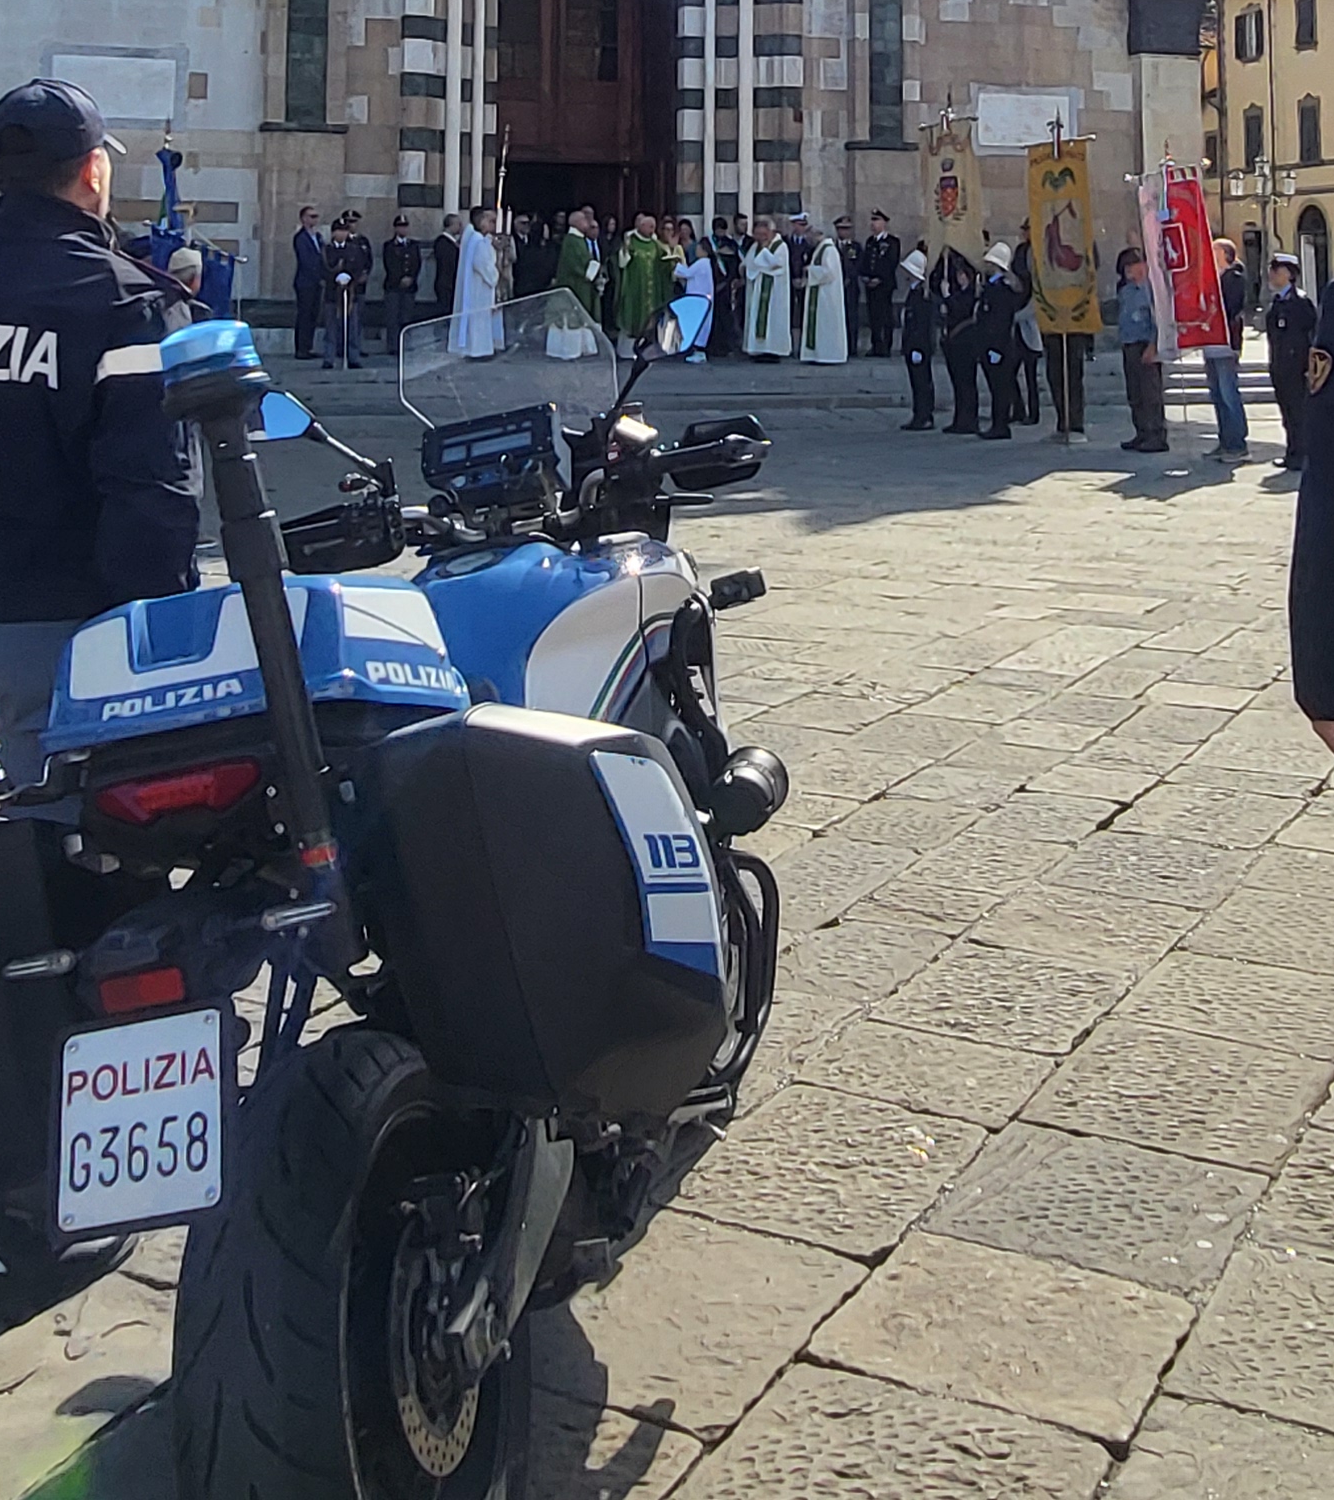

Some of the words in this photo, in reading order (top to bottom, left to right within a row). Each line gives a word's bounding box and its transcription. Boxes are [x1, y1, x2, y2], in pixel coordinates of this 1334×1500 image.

[102, 678, 244, 722] POLIZIA
[643, 833, 701, 869] 113
[67, 1046, 215, 1107] POLIZIA
[69, 1111, 209, 1193] G3658
